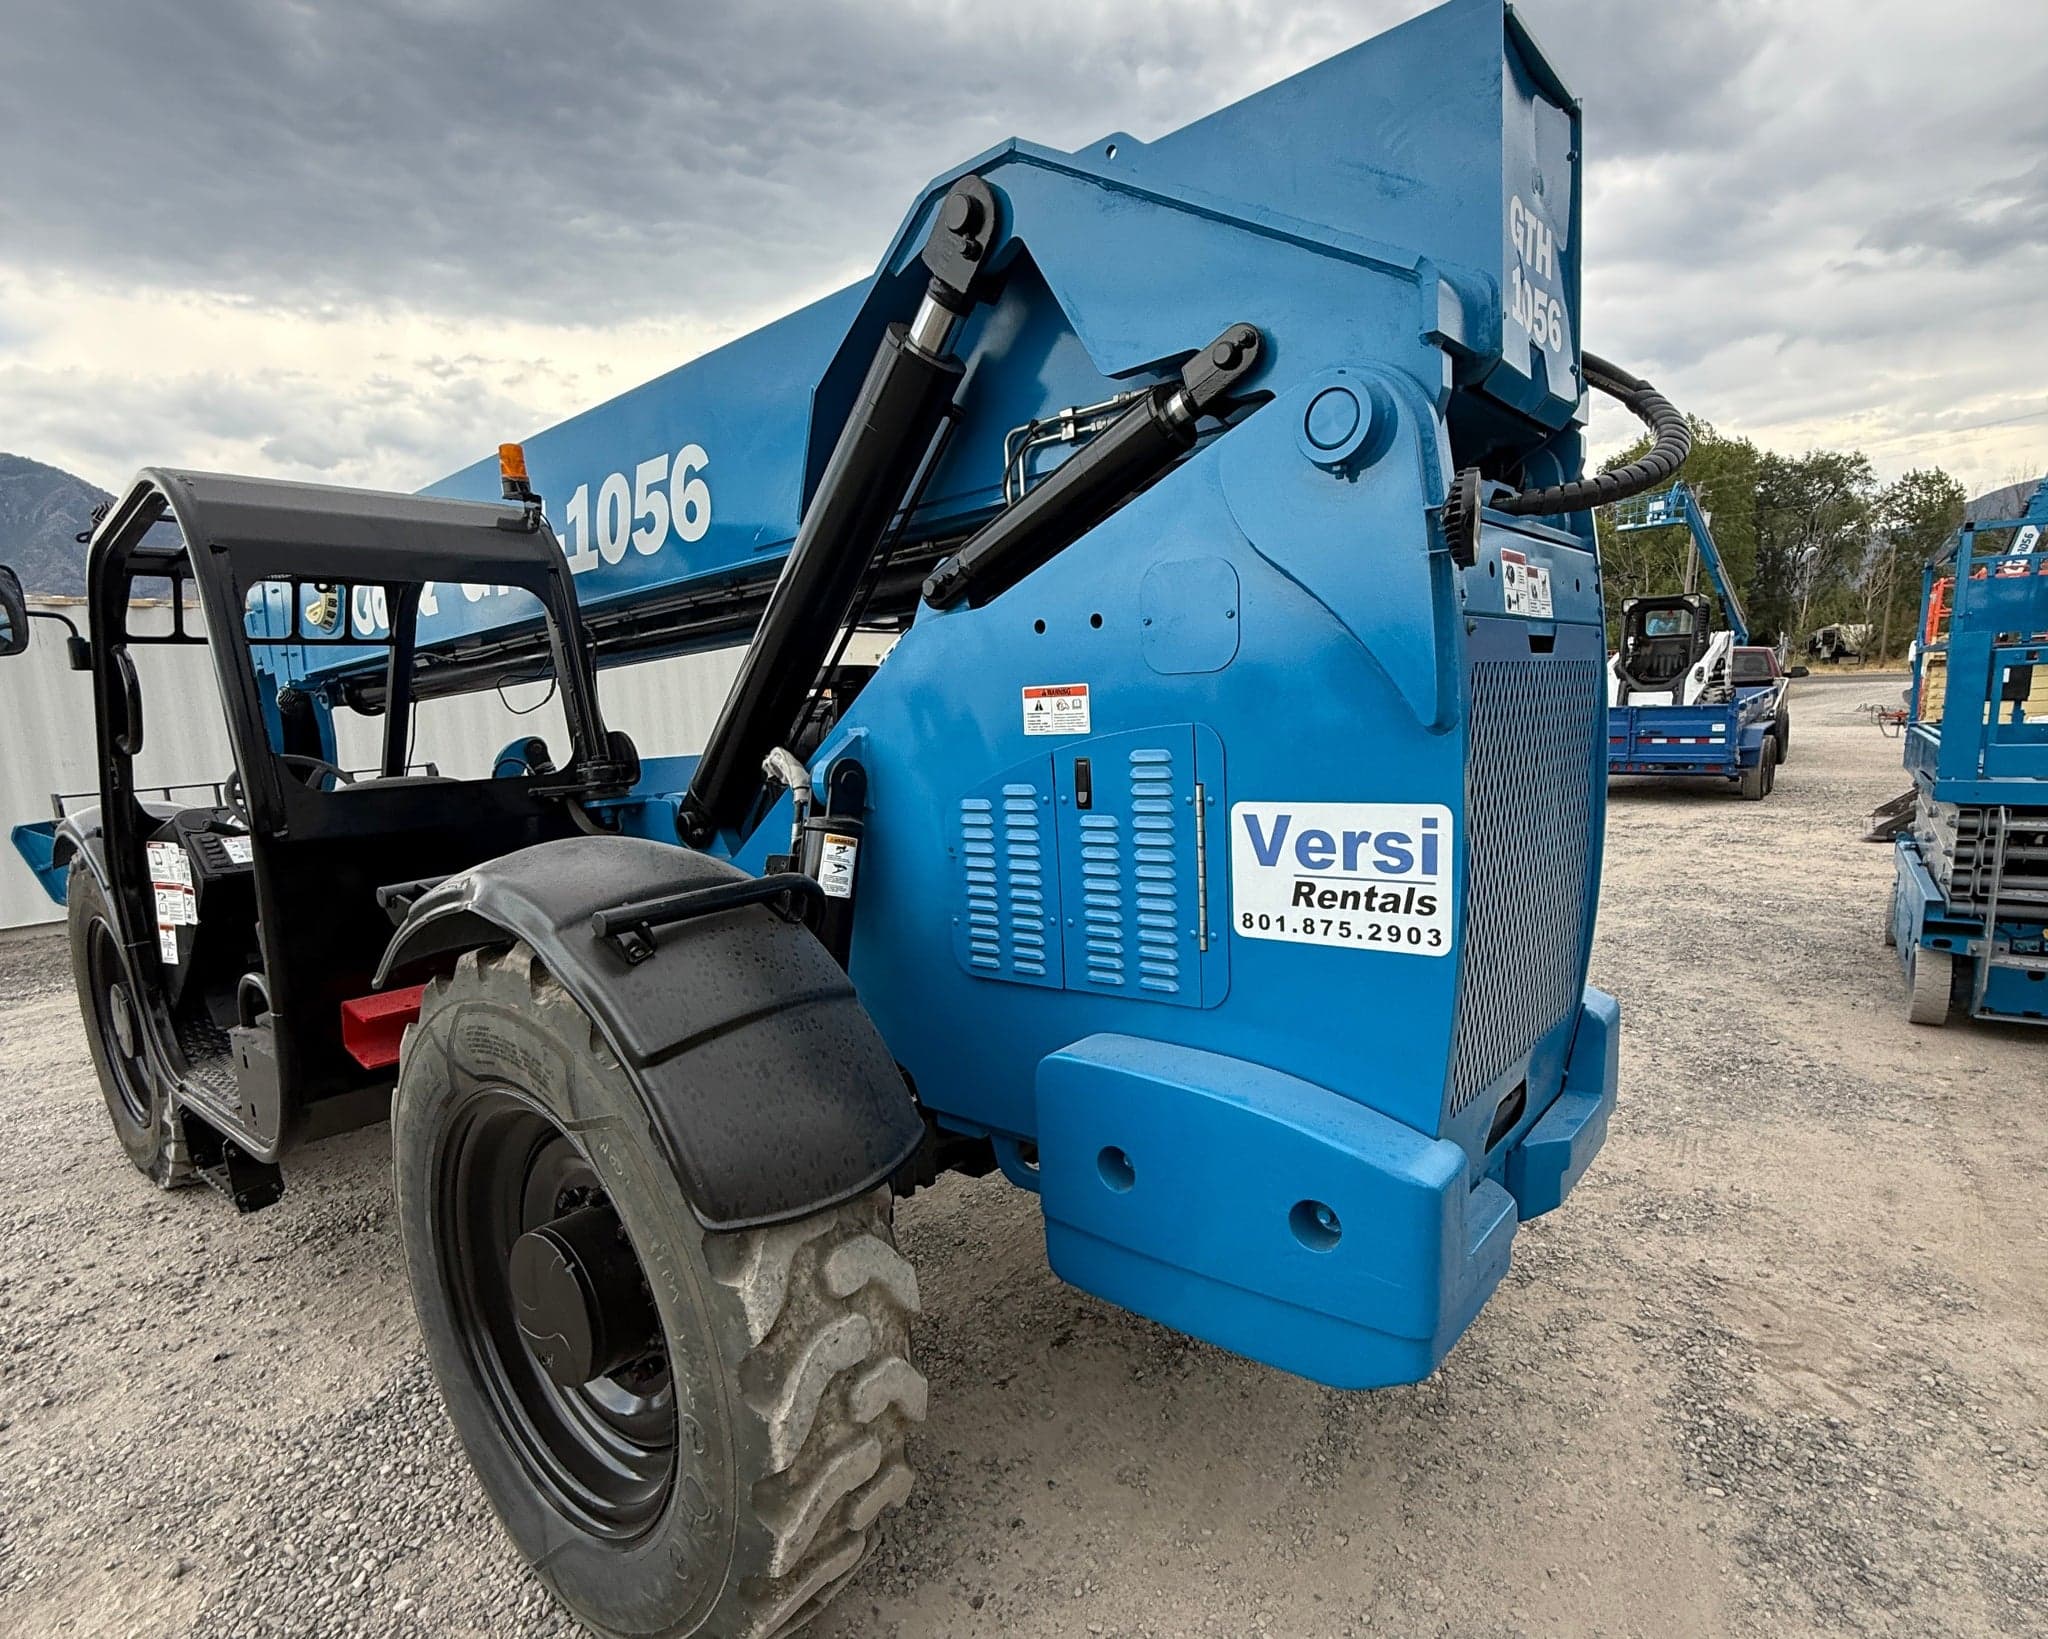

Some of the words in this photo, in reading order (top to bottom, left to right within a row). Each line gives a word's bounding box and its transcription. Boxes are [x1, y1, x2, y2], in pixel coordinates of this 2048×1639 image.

[1510, 195, 1552, 281] GTH
[1512, 267, 1562, 353] 1056
[1242, 814, 1439, 876] Versi
[1241, 912, 1442, 947] 801.875.2903
[1291, 880, 1438, 917] Rentals
